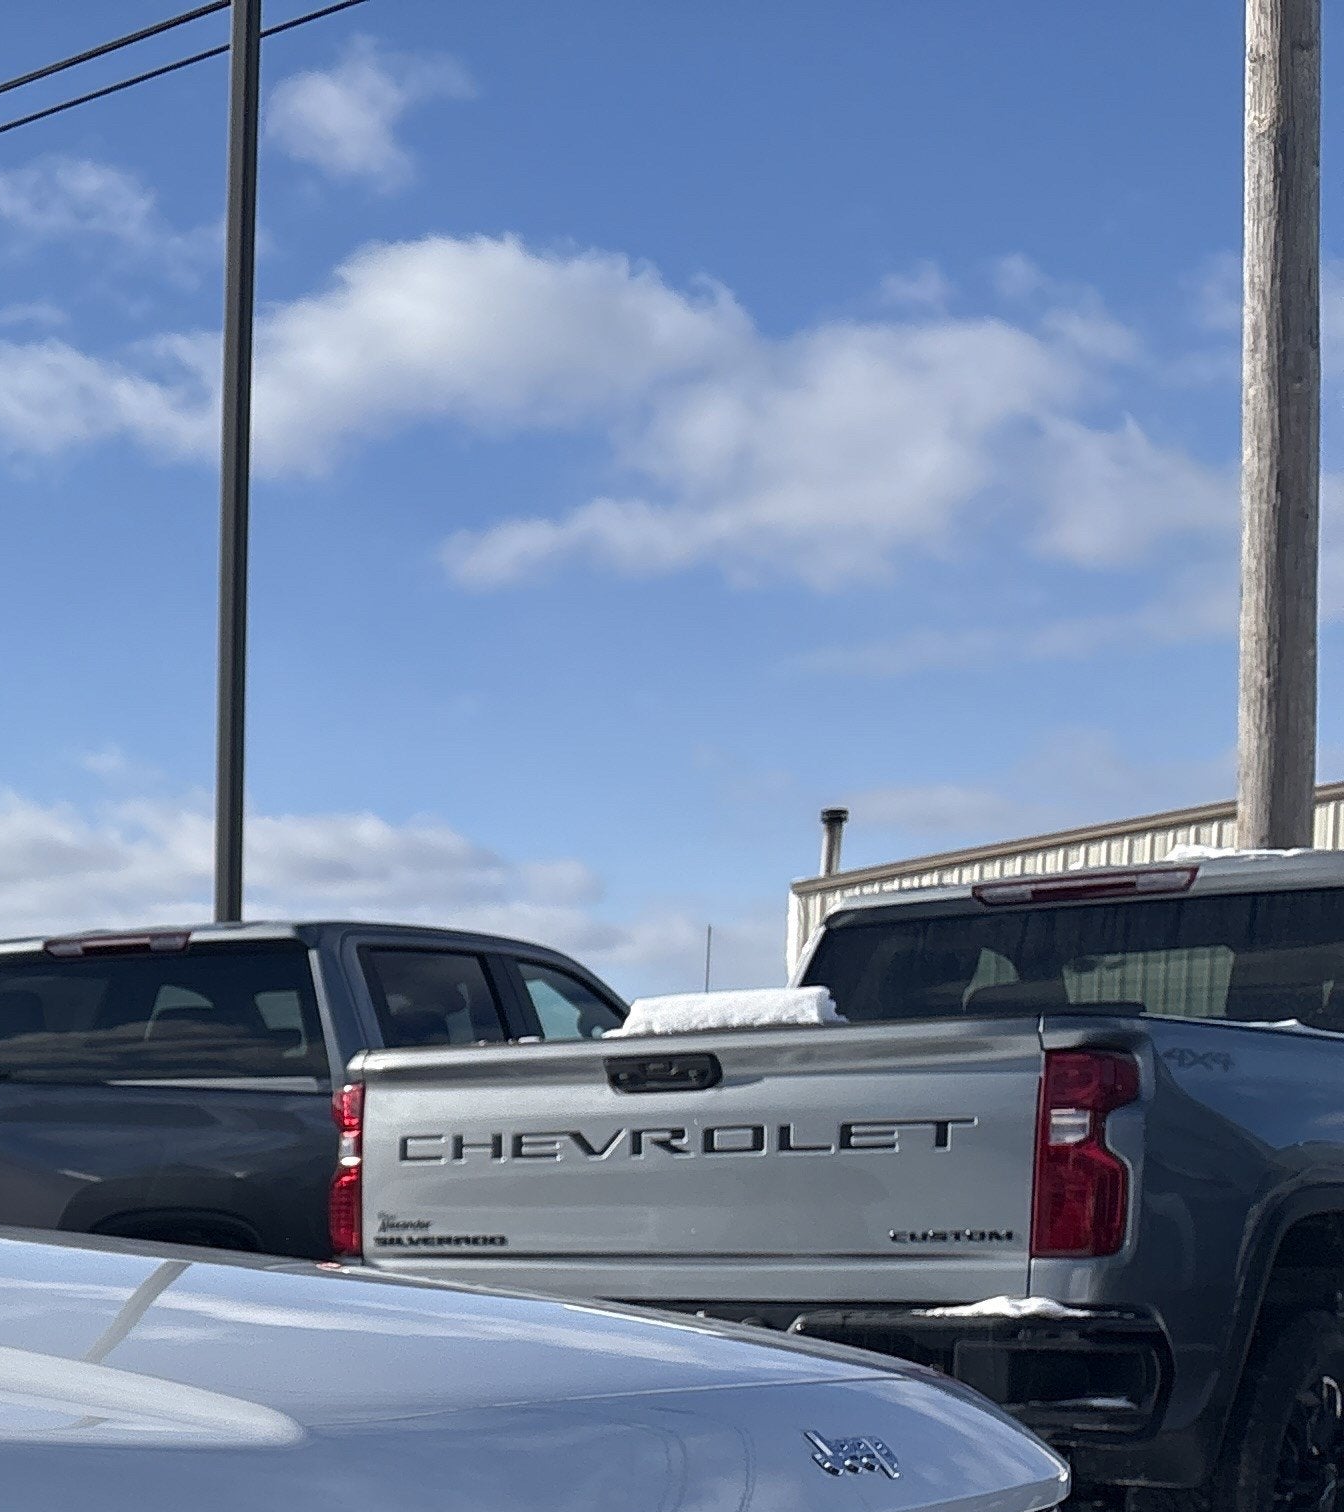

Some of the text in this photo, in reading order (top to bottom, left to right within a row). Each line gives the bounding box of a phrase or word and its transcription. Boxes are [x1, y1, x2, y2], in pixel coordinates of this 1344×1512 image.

[398, 1116, 979, 1168] CHEVROLET
[889, 1228, 1015, 1242] CUSTOM
[804, 1430, 900, 1481] Jeep
